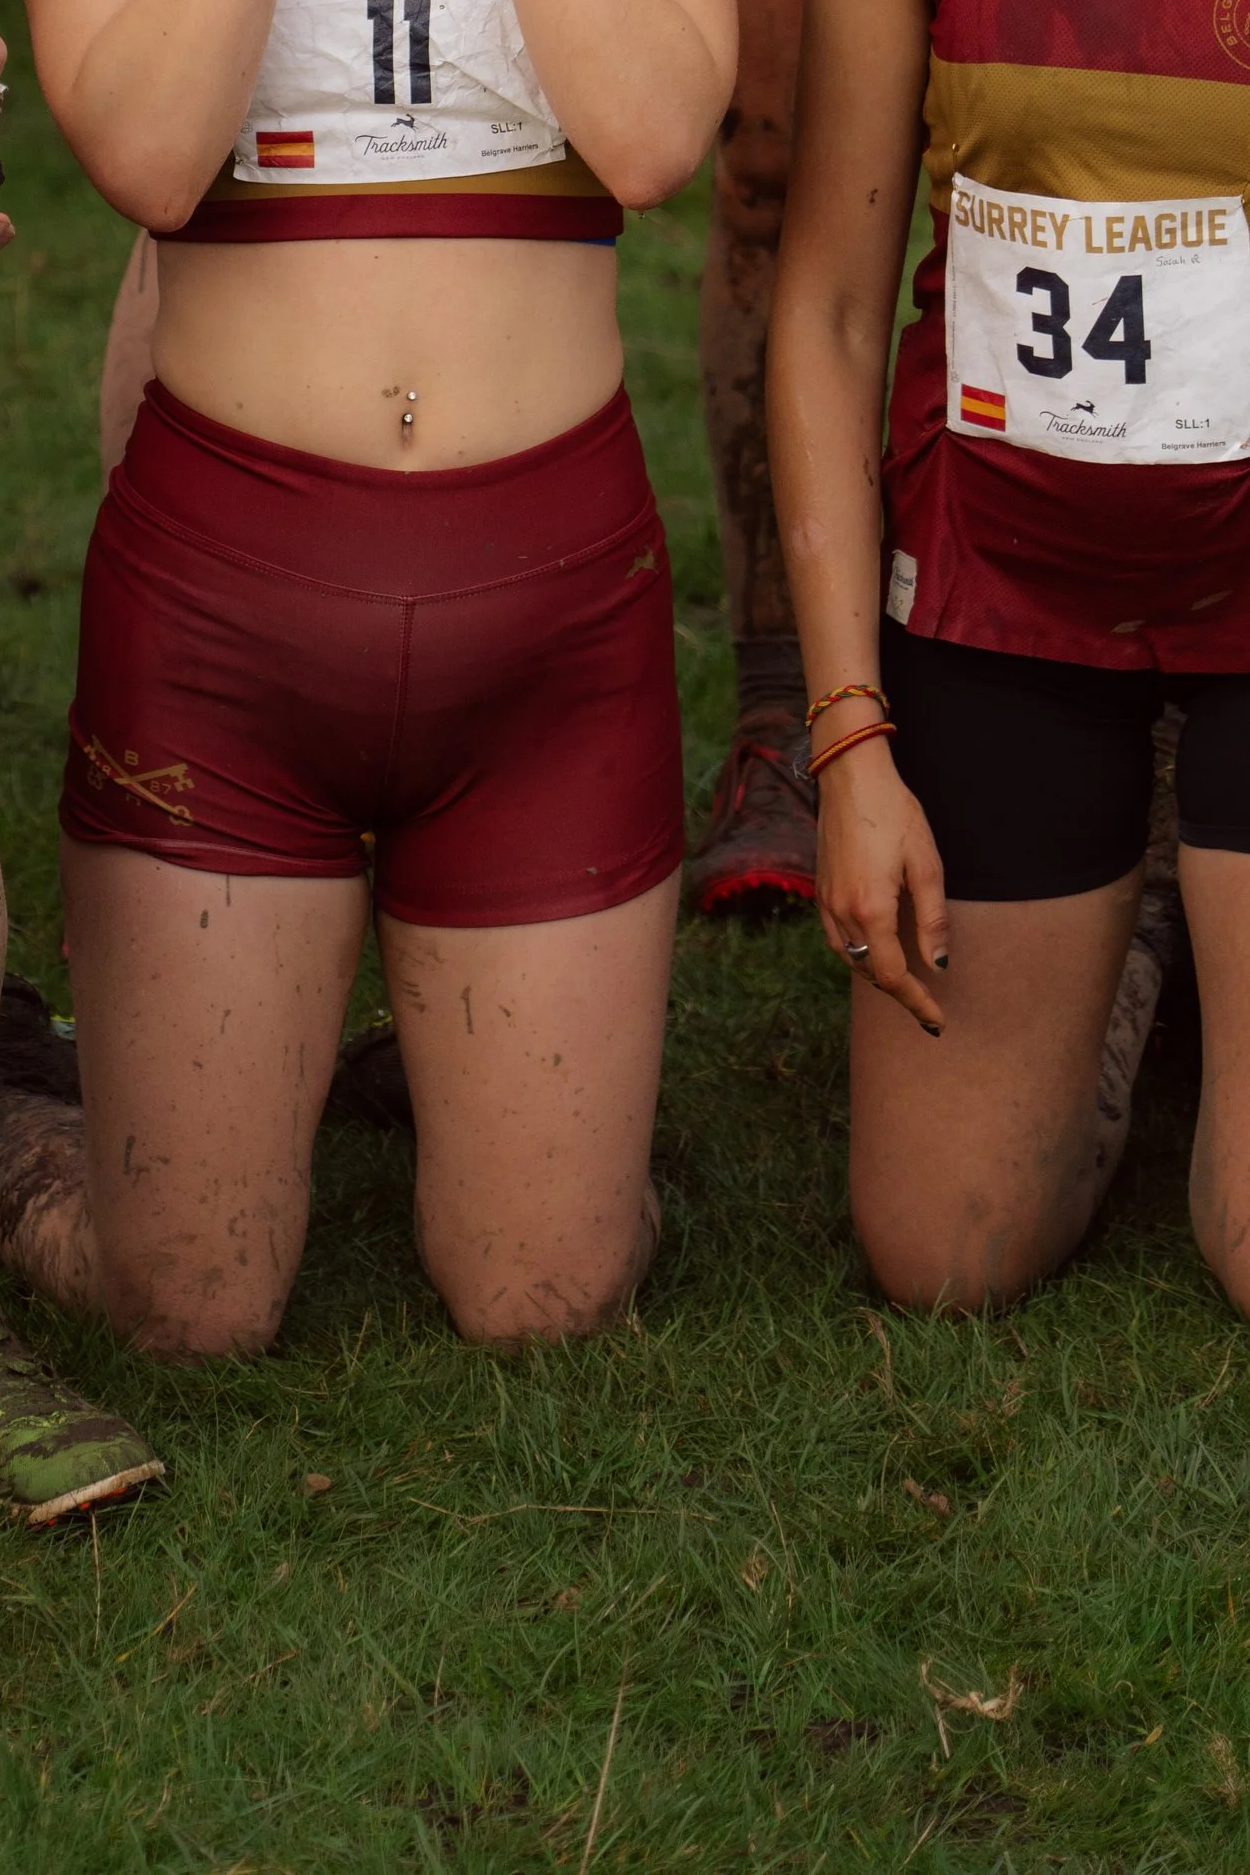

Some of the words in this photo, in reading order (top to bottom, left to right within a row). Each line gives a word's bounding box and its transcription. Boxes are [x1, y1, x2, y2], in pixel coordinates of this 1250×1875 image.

[491, 122, 522, 134] SLL:1
[355, 133, 448, 156] Tracksmith
[481, 148, 511, 158] Belgrave
[513, 143, 539, 153] Harriers
[955, 190, 1070, 251] SURREY
[1085, 209, 1228, 254] LEAGUE
[1016, 266, 1151, 385] 34
[1040, 411, 1127, 438] Tracksmith
[1175, 418, 1211, 430] SLL:1
[1161, 443, 1195, 452] Belgrave
[1197, 440, 1226, 448] Harriers
